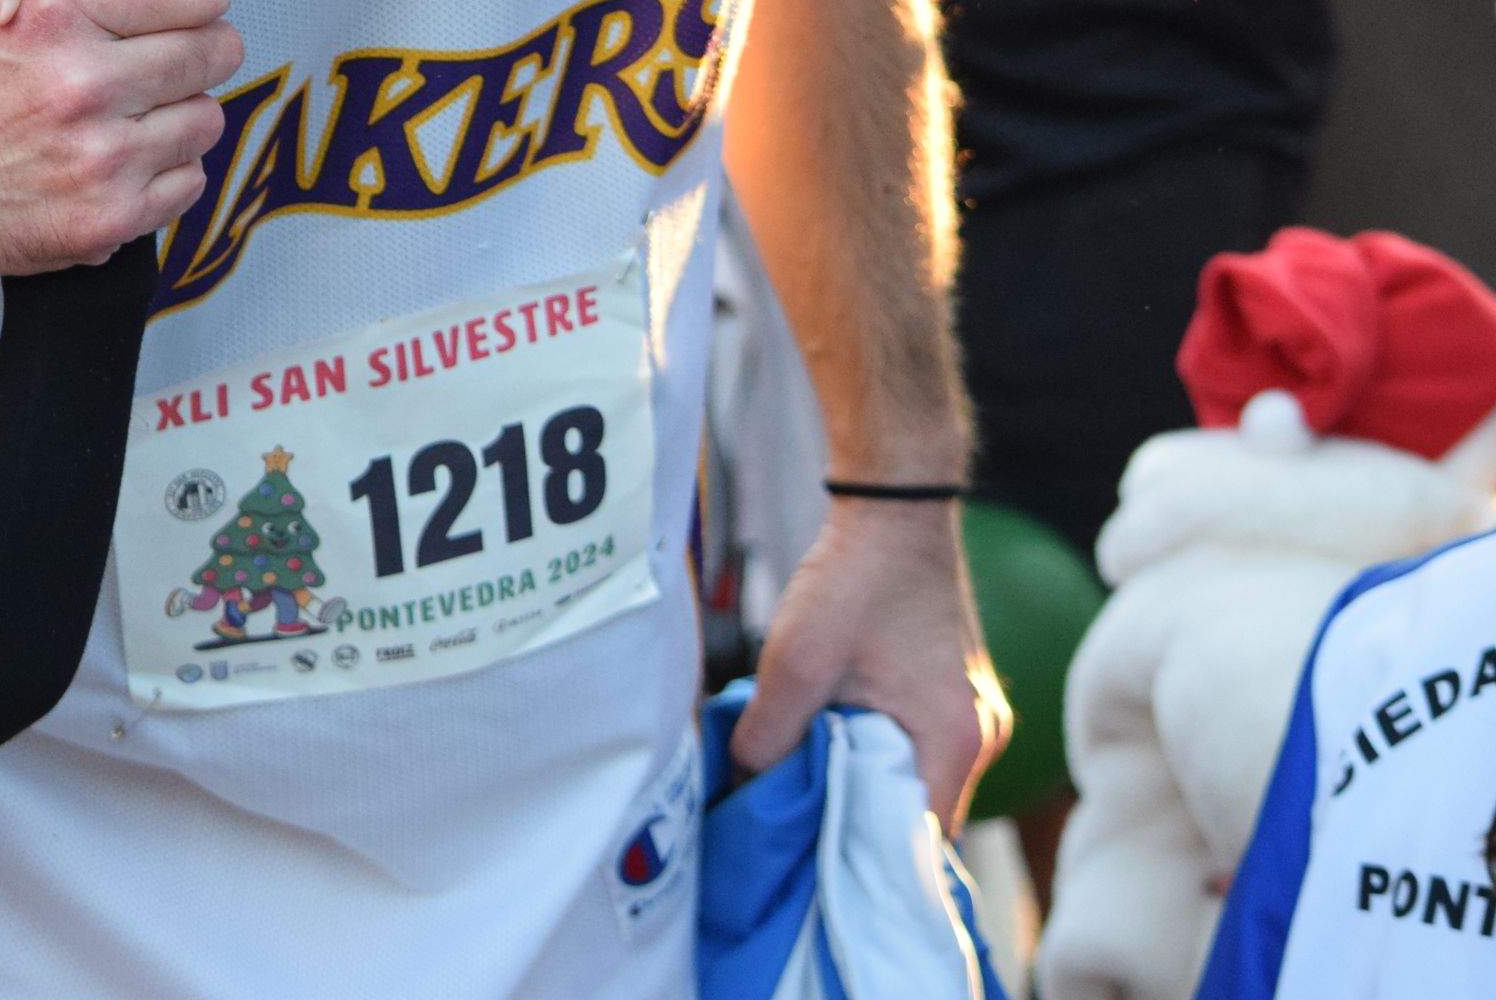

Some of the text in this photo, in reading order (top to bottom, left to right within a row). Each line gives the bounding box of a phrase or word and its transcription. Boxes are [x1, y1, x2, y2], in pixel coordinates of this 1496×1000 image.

[155, 285, 600, 431] XLI SAN SILVESTRE
[349, 404, 606, 578] 1218
[336, 568, 536, 633] PONTEVEDRA
[547, 535, 615, 583] 2024
